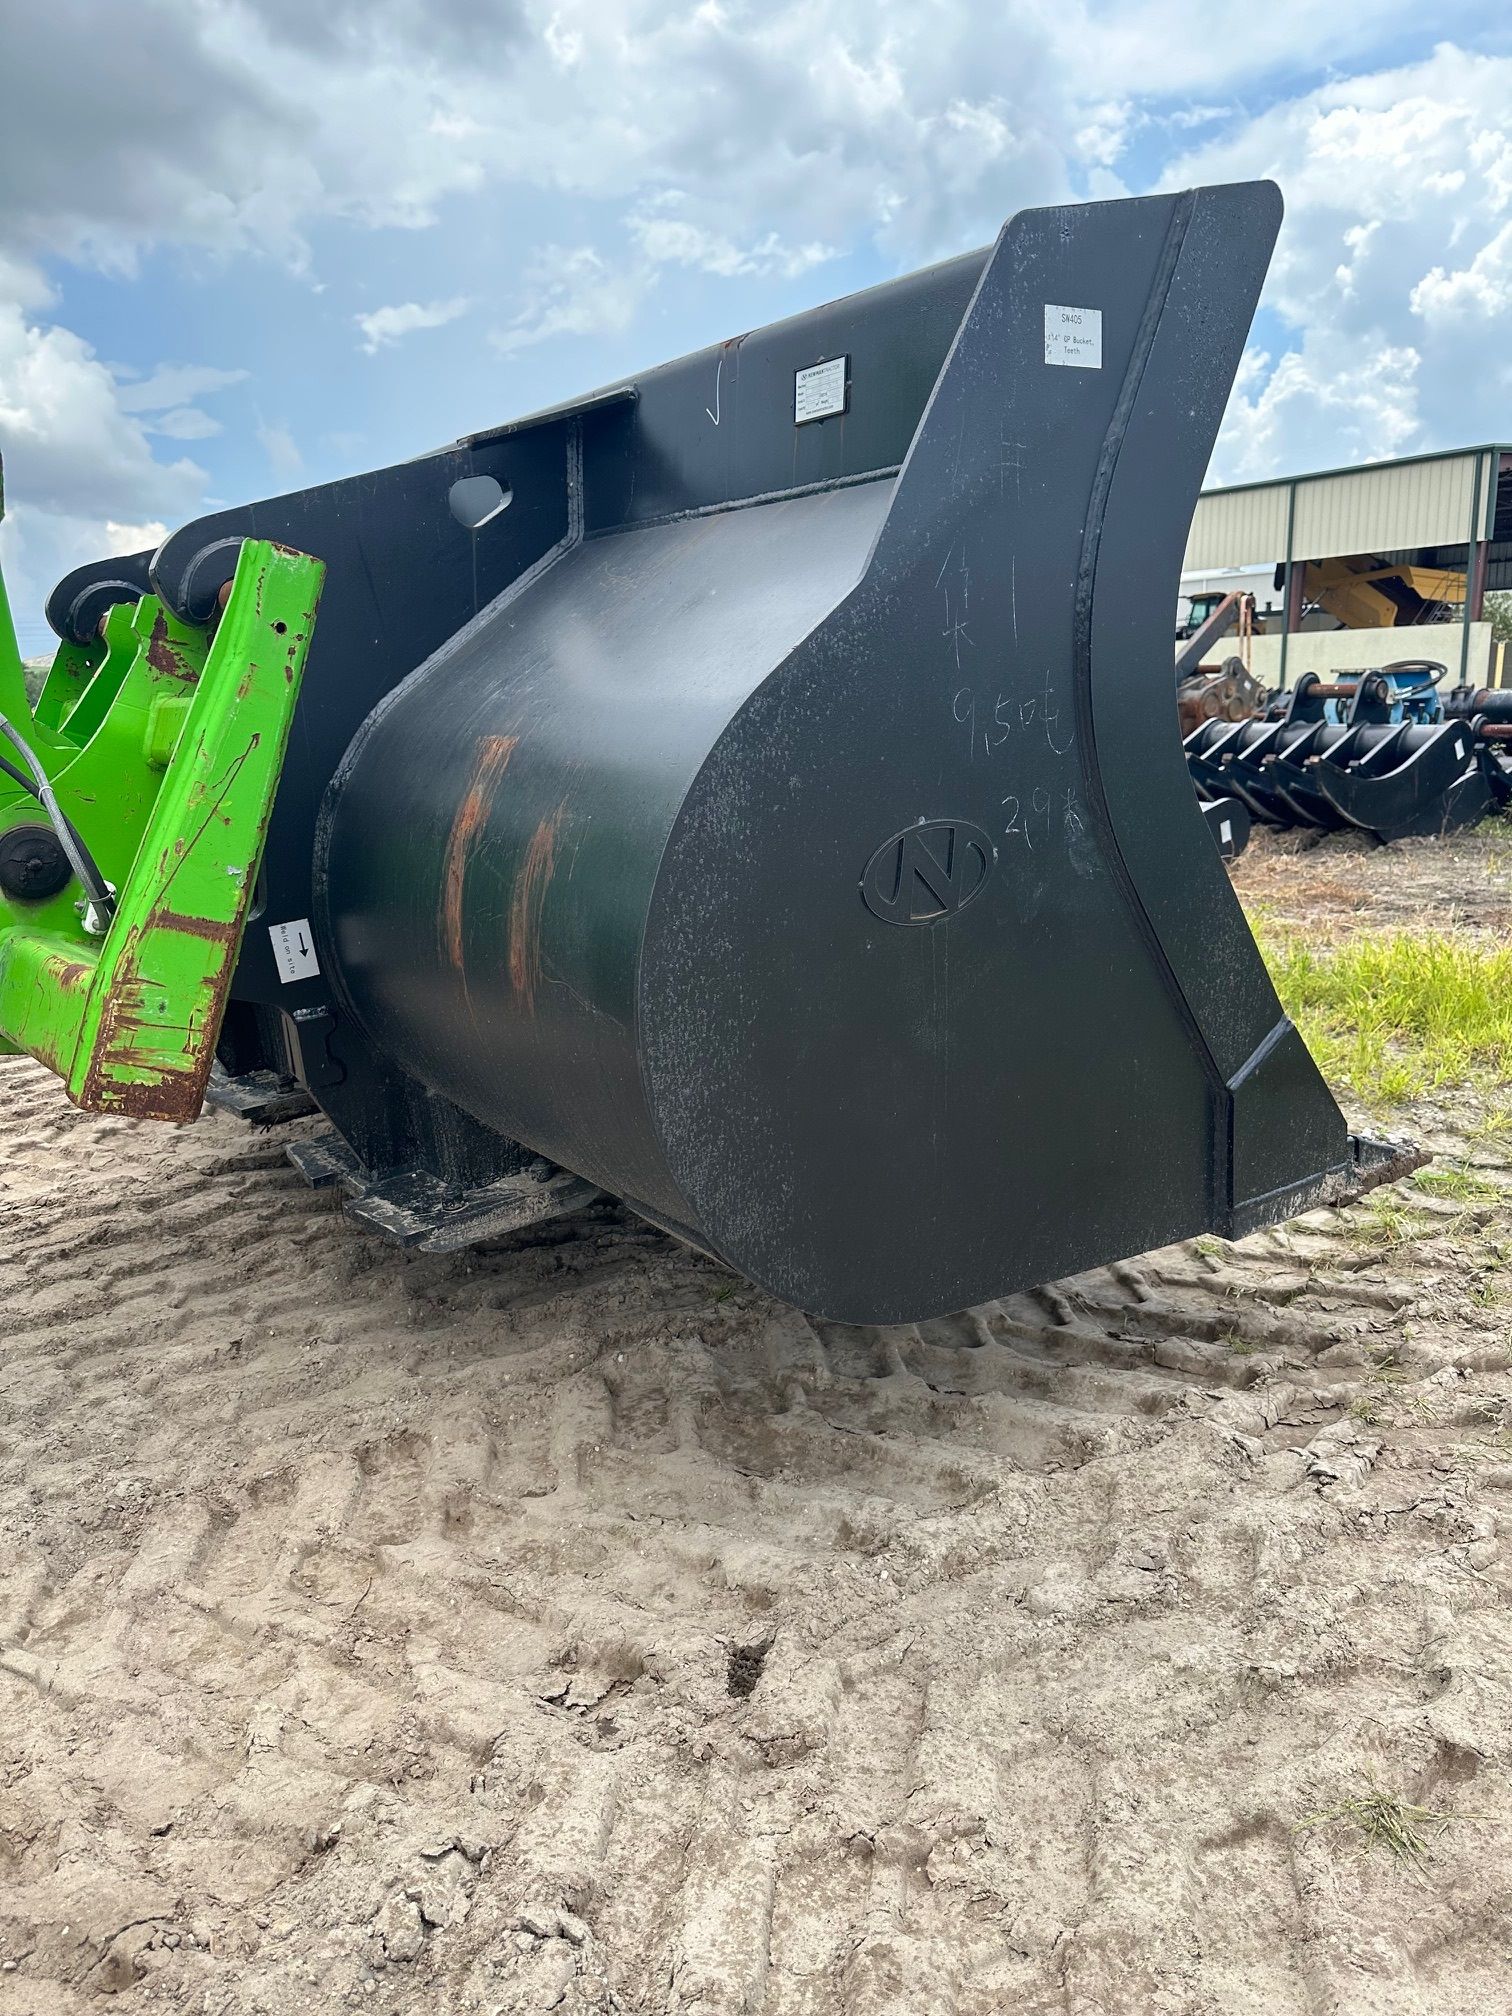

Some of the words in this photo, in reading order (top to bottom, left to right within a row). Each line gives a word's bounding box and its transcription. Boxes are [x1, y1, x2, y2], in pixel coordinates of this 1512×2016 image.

[1061, 313, 1082, 325] SN405
[1064, 346, 1081, 355] Teeth
[284, 945, 291, 955] on
[287, 957, 296, 975] site
